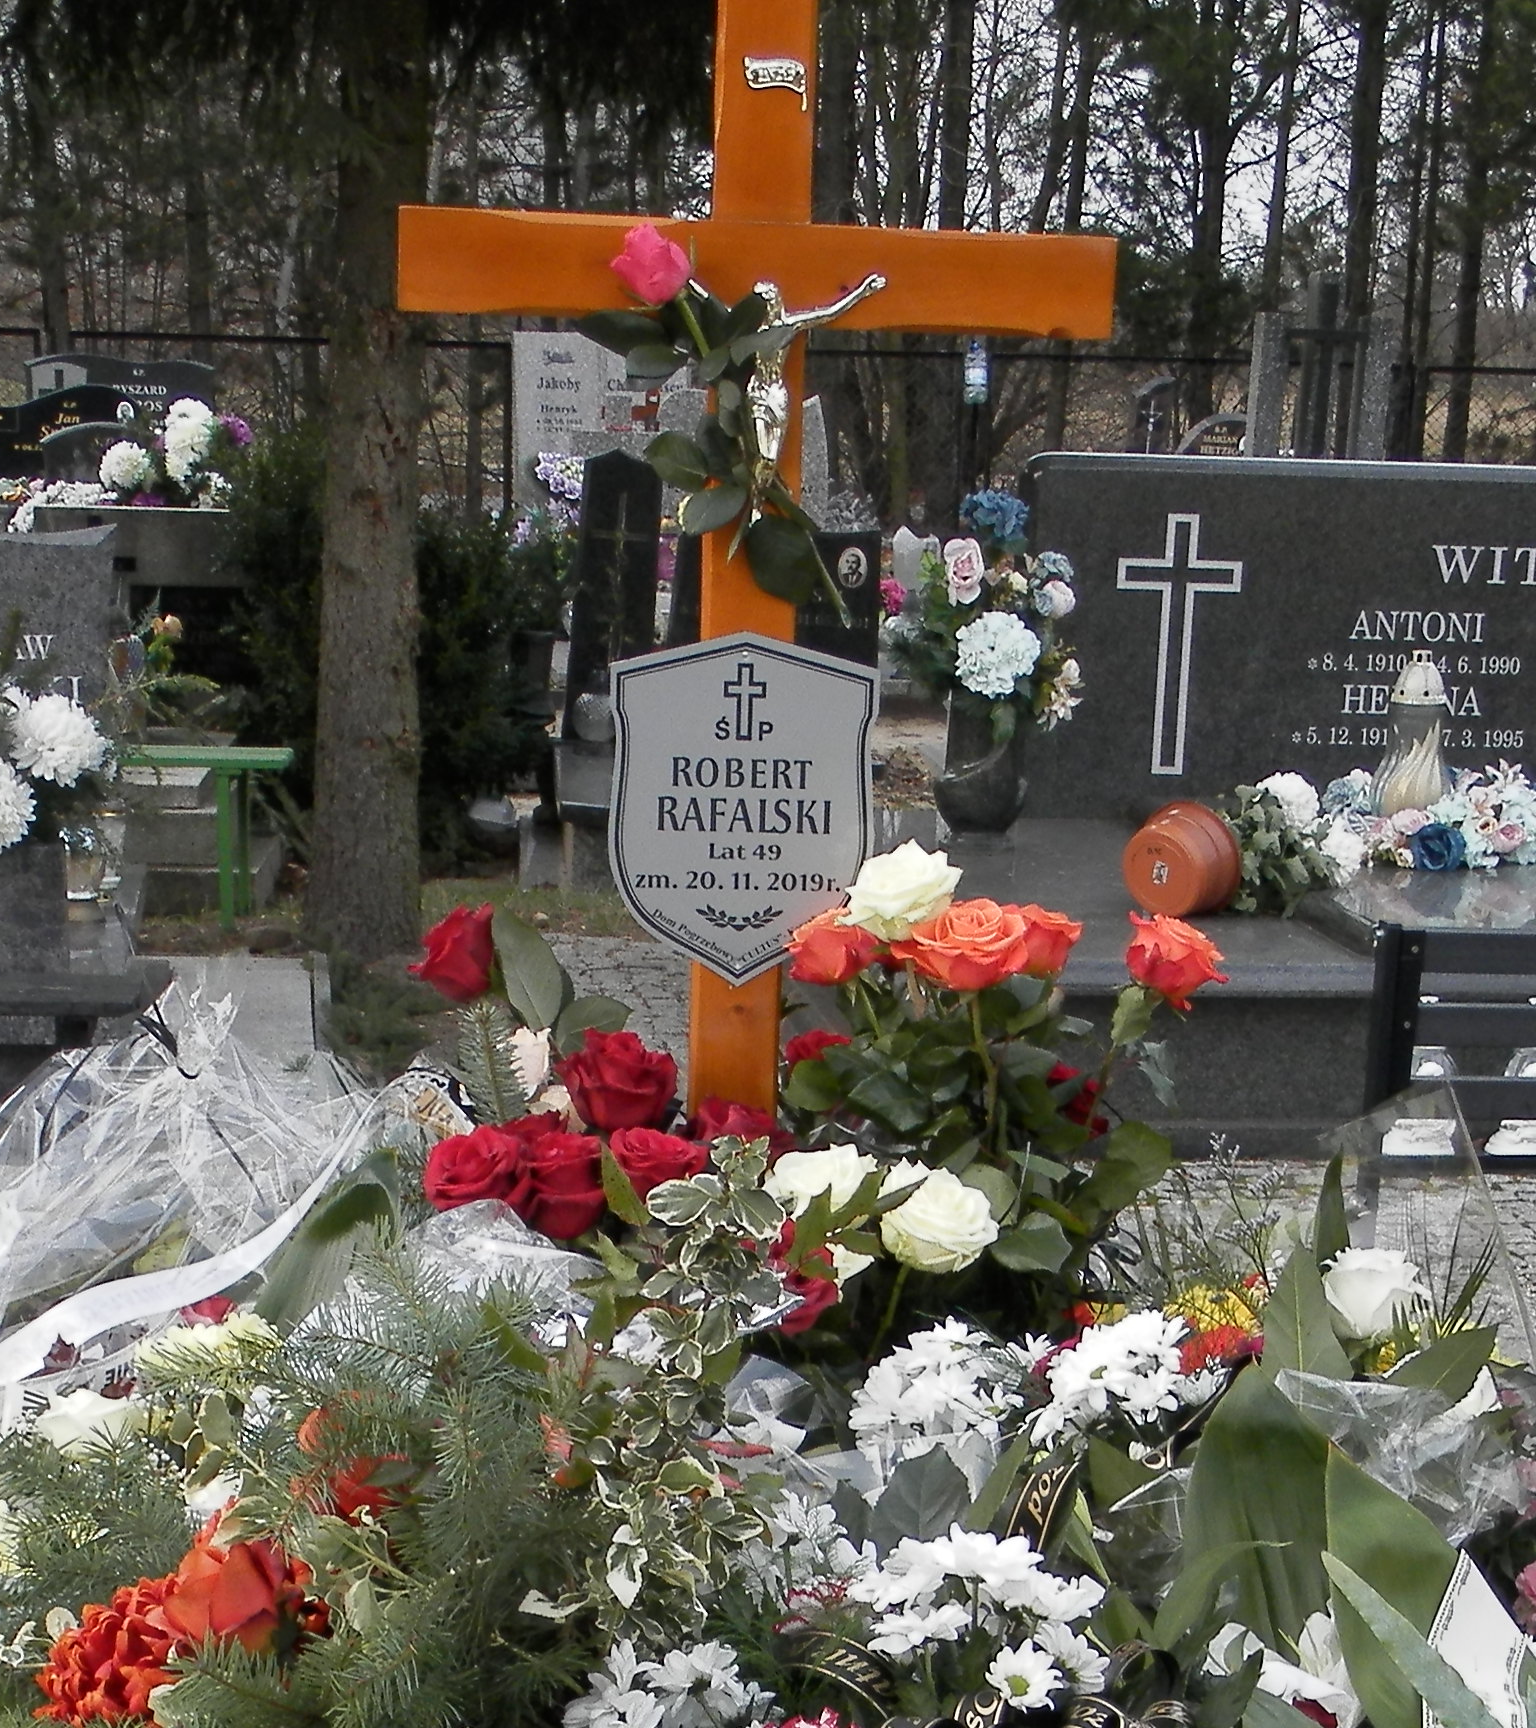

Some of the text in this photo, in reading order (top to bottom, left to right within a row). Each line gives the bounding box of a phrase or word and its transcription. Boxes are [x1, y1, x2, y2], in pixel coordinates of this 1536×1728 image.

[536, 377, 582, 393] Jakoby
[1348, 609, 1486, 644] ANTONI
[1479, 656, 1521, 675] 1990
[1340, 683, 1483, 718] HENA
[758, 720, 774, 741] P
[1482, 729, 1525, 749] 1995
[671, 755, 813, 790] ROBERT
[656, 795, 832, 835] RAFALSKI
[708, 842, 783, 861] Lat 49
[634, 873, 678, 890] zm.
[766, 872, 842, 893] 2019r.
[651, 907, 677, 927] Dom
